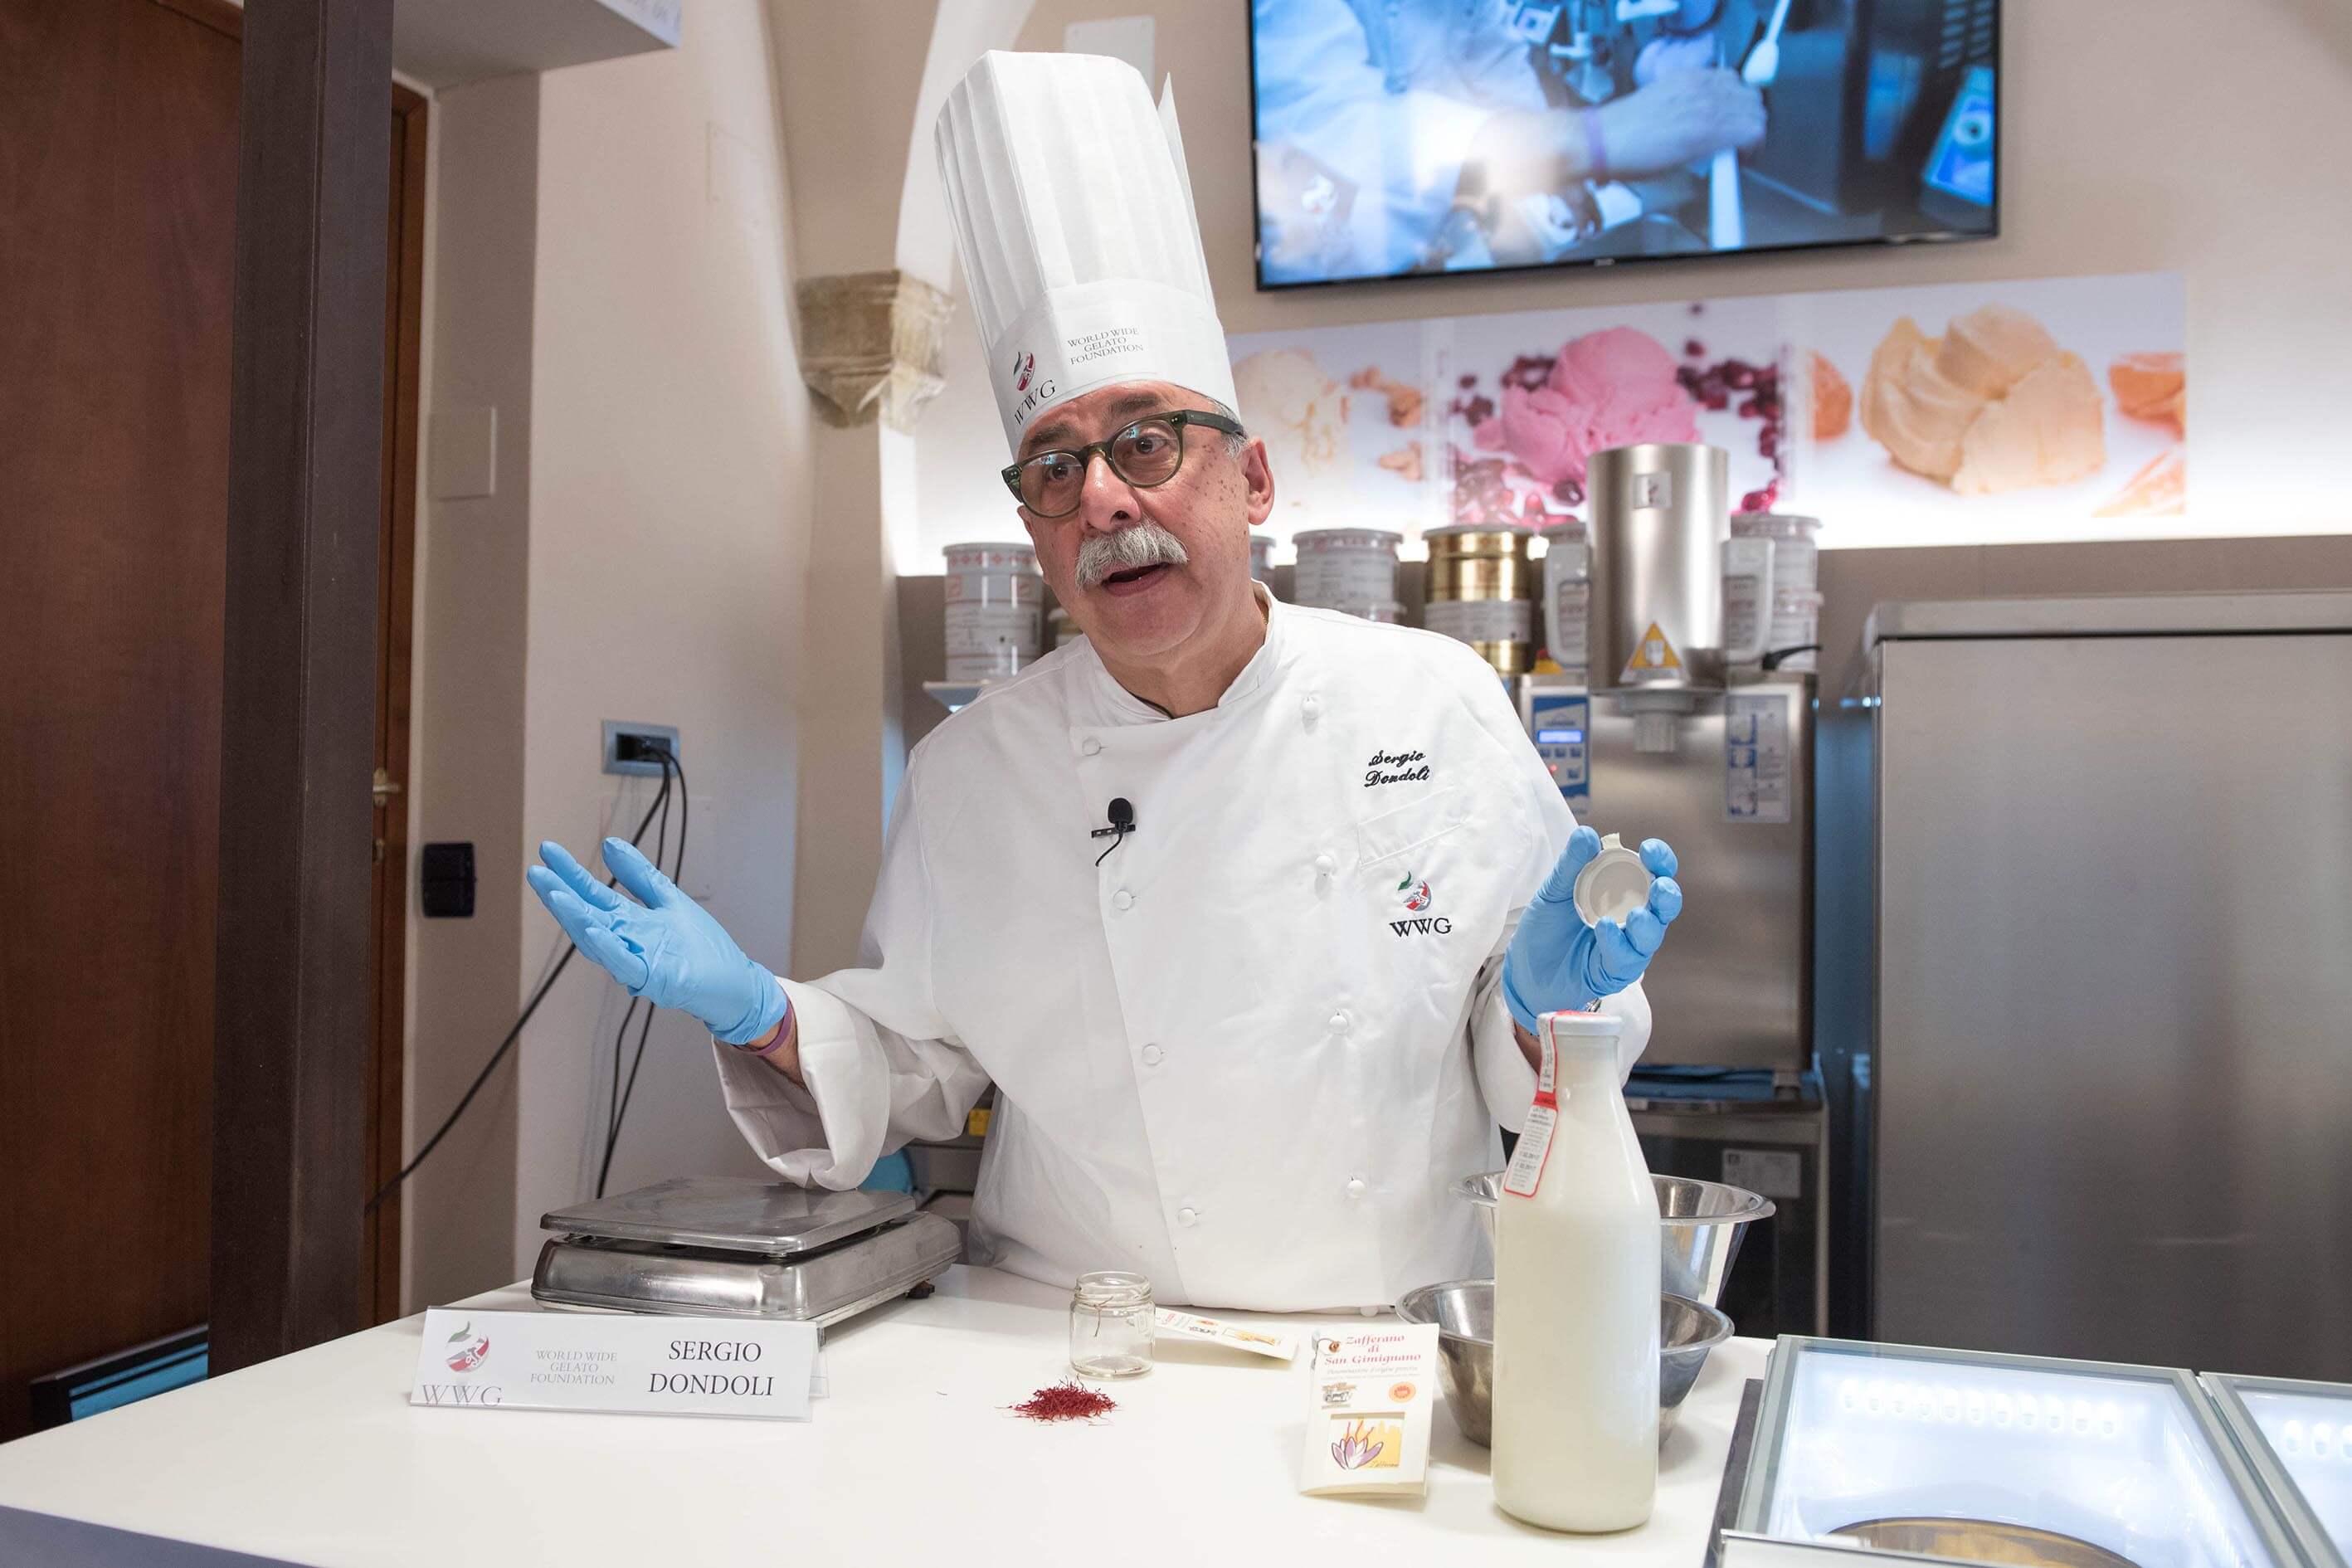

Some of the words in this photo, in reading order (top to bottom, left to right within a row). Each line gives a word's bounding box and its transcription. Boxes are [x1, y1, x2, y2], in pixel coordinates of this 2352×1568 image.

[1067, 331, 1110, 348] WORLD
[1110, 326, 1140, 338] WIDE
[1083, 336, 1127, 353] GELATO
[1070, 343, 1144, 365] FOUNDATION
[1014, 379, 1056, 426] WWG
[1368, 749, 1426, 768] Sergio
[1364, 765, 1430, 788] Dondoli
[1389, 918, 1452, 937] WWG
[1346, 1334, 1405, 1346] Zafferano
[1367, 1345, 1381, 1353] di
[536, 1349, 583, 1361] WORLD
[584, 1351, 617, 1362] WIDE
[668, 1340, 762, 1363] SERGIO
[1324, 1356, 1346, 1366] San
[1351, 1353, 1421, 1366] Gimignano
[549, 1361, 598, 1374] GELATO
[530, 1372, 615, 1385] FOUNDATION
[648, 1372, 775, 1397] DONDOLI
[421, 1384, 504, 1407] WWG
